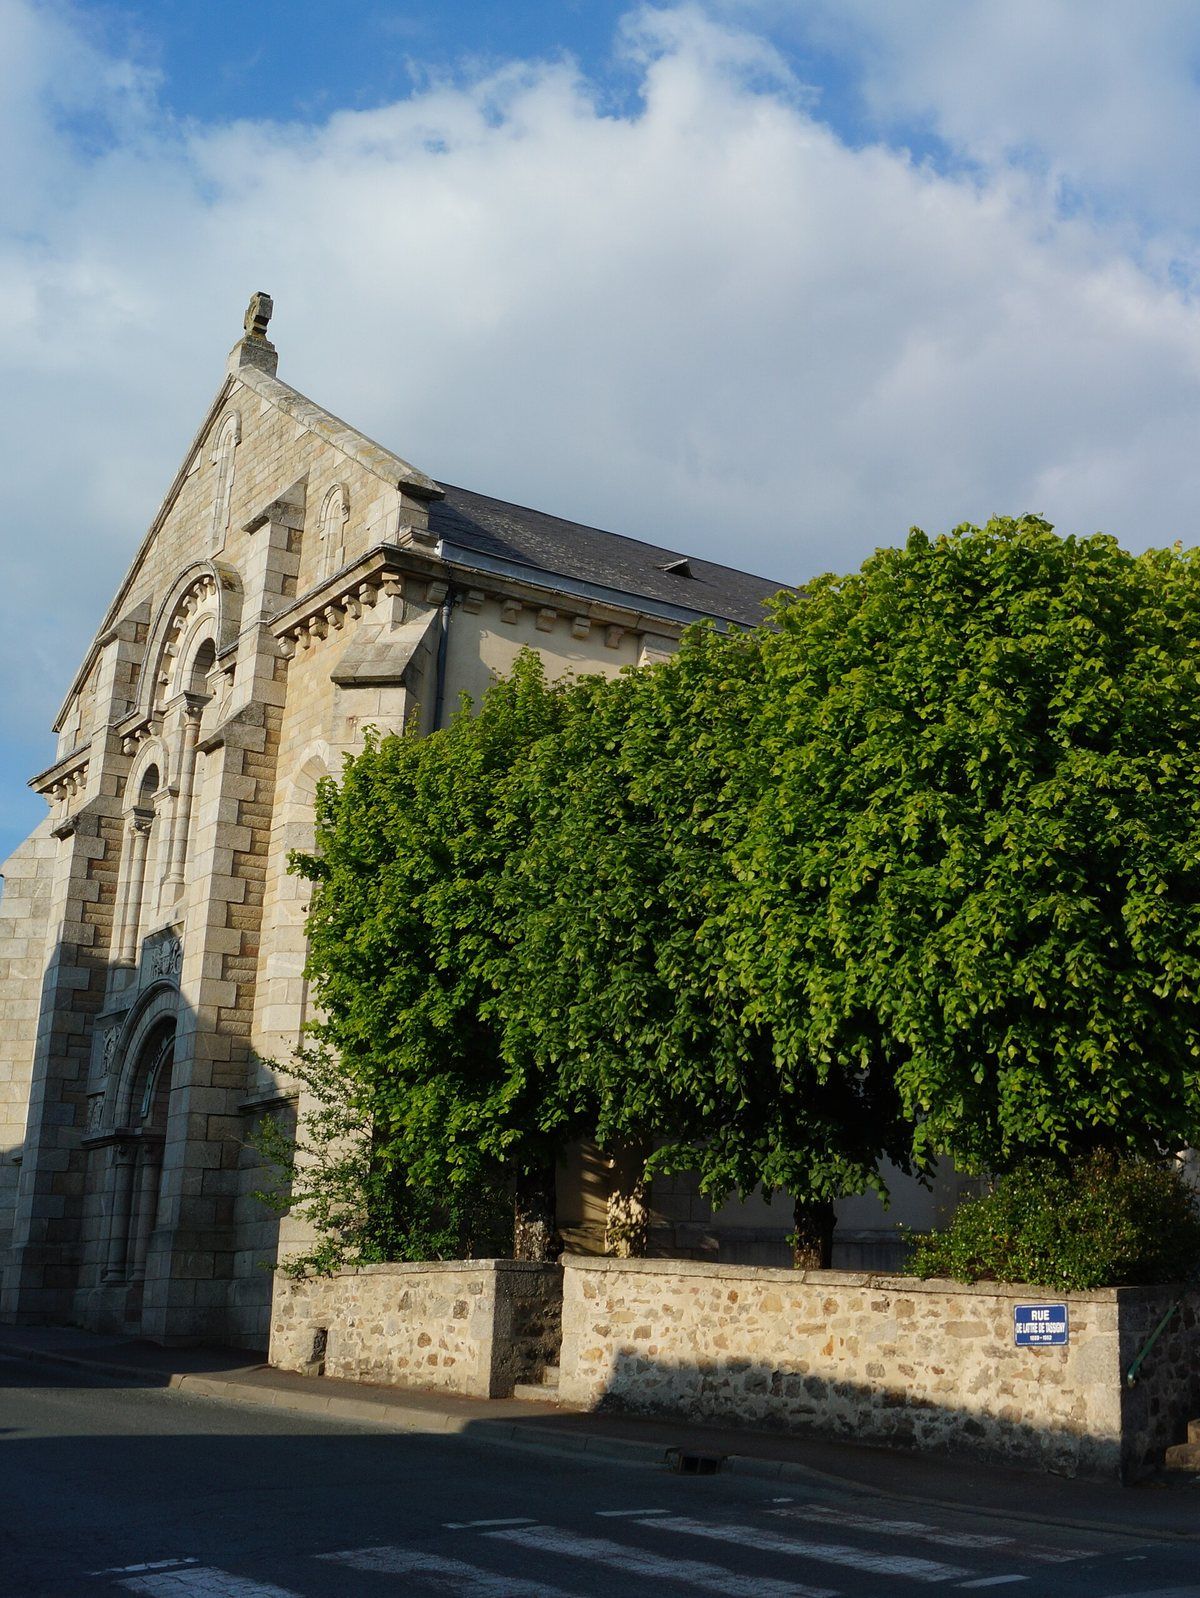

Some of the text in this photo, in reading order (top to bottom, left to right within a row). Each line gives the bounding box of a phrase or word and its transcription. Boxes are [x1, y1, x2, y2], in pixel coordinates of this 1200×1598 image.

[1031, 1310, 1050, 1321] RUE
[1016, 1322, 1023, 1334] DE
[1023, 1322, 1038, 1334] LATTRE
[1038, 1322, 1046, 1333] DE
